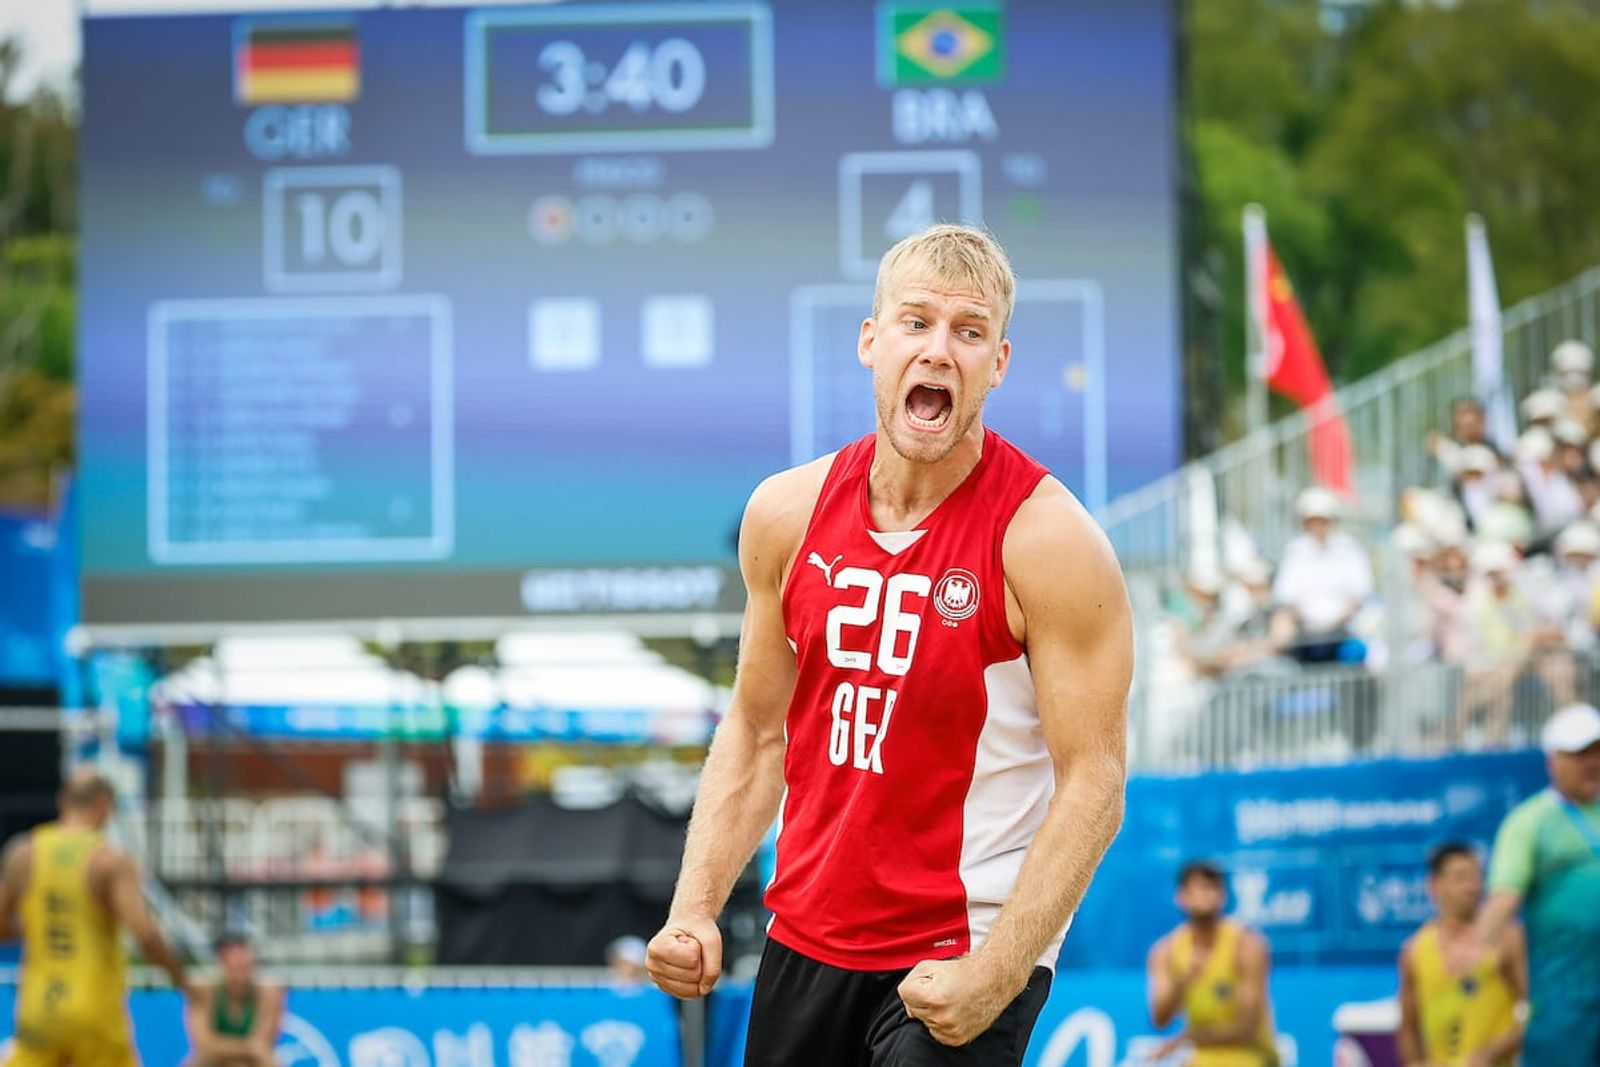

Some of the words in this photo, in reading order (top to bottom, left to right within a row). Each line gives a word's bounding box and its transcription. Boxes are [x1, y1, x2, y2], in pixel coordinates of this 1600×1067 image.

[536, 38, 706, 114] 3:40
[243, 104, 352, 160] GER
[892, 90, 998, 143] BRA
[297, 190, 385, 266] 10
[882, 179, 936, 240] 4
[825, 567, 932, 676] 26
